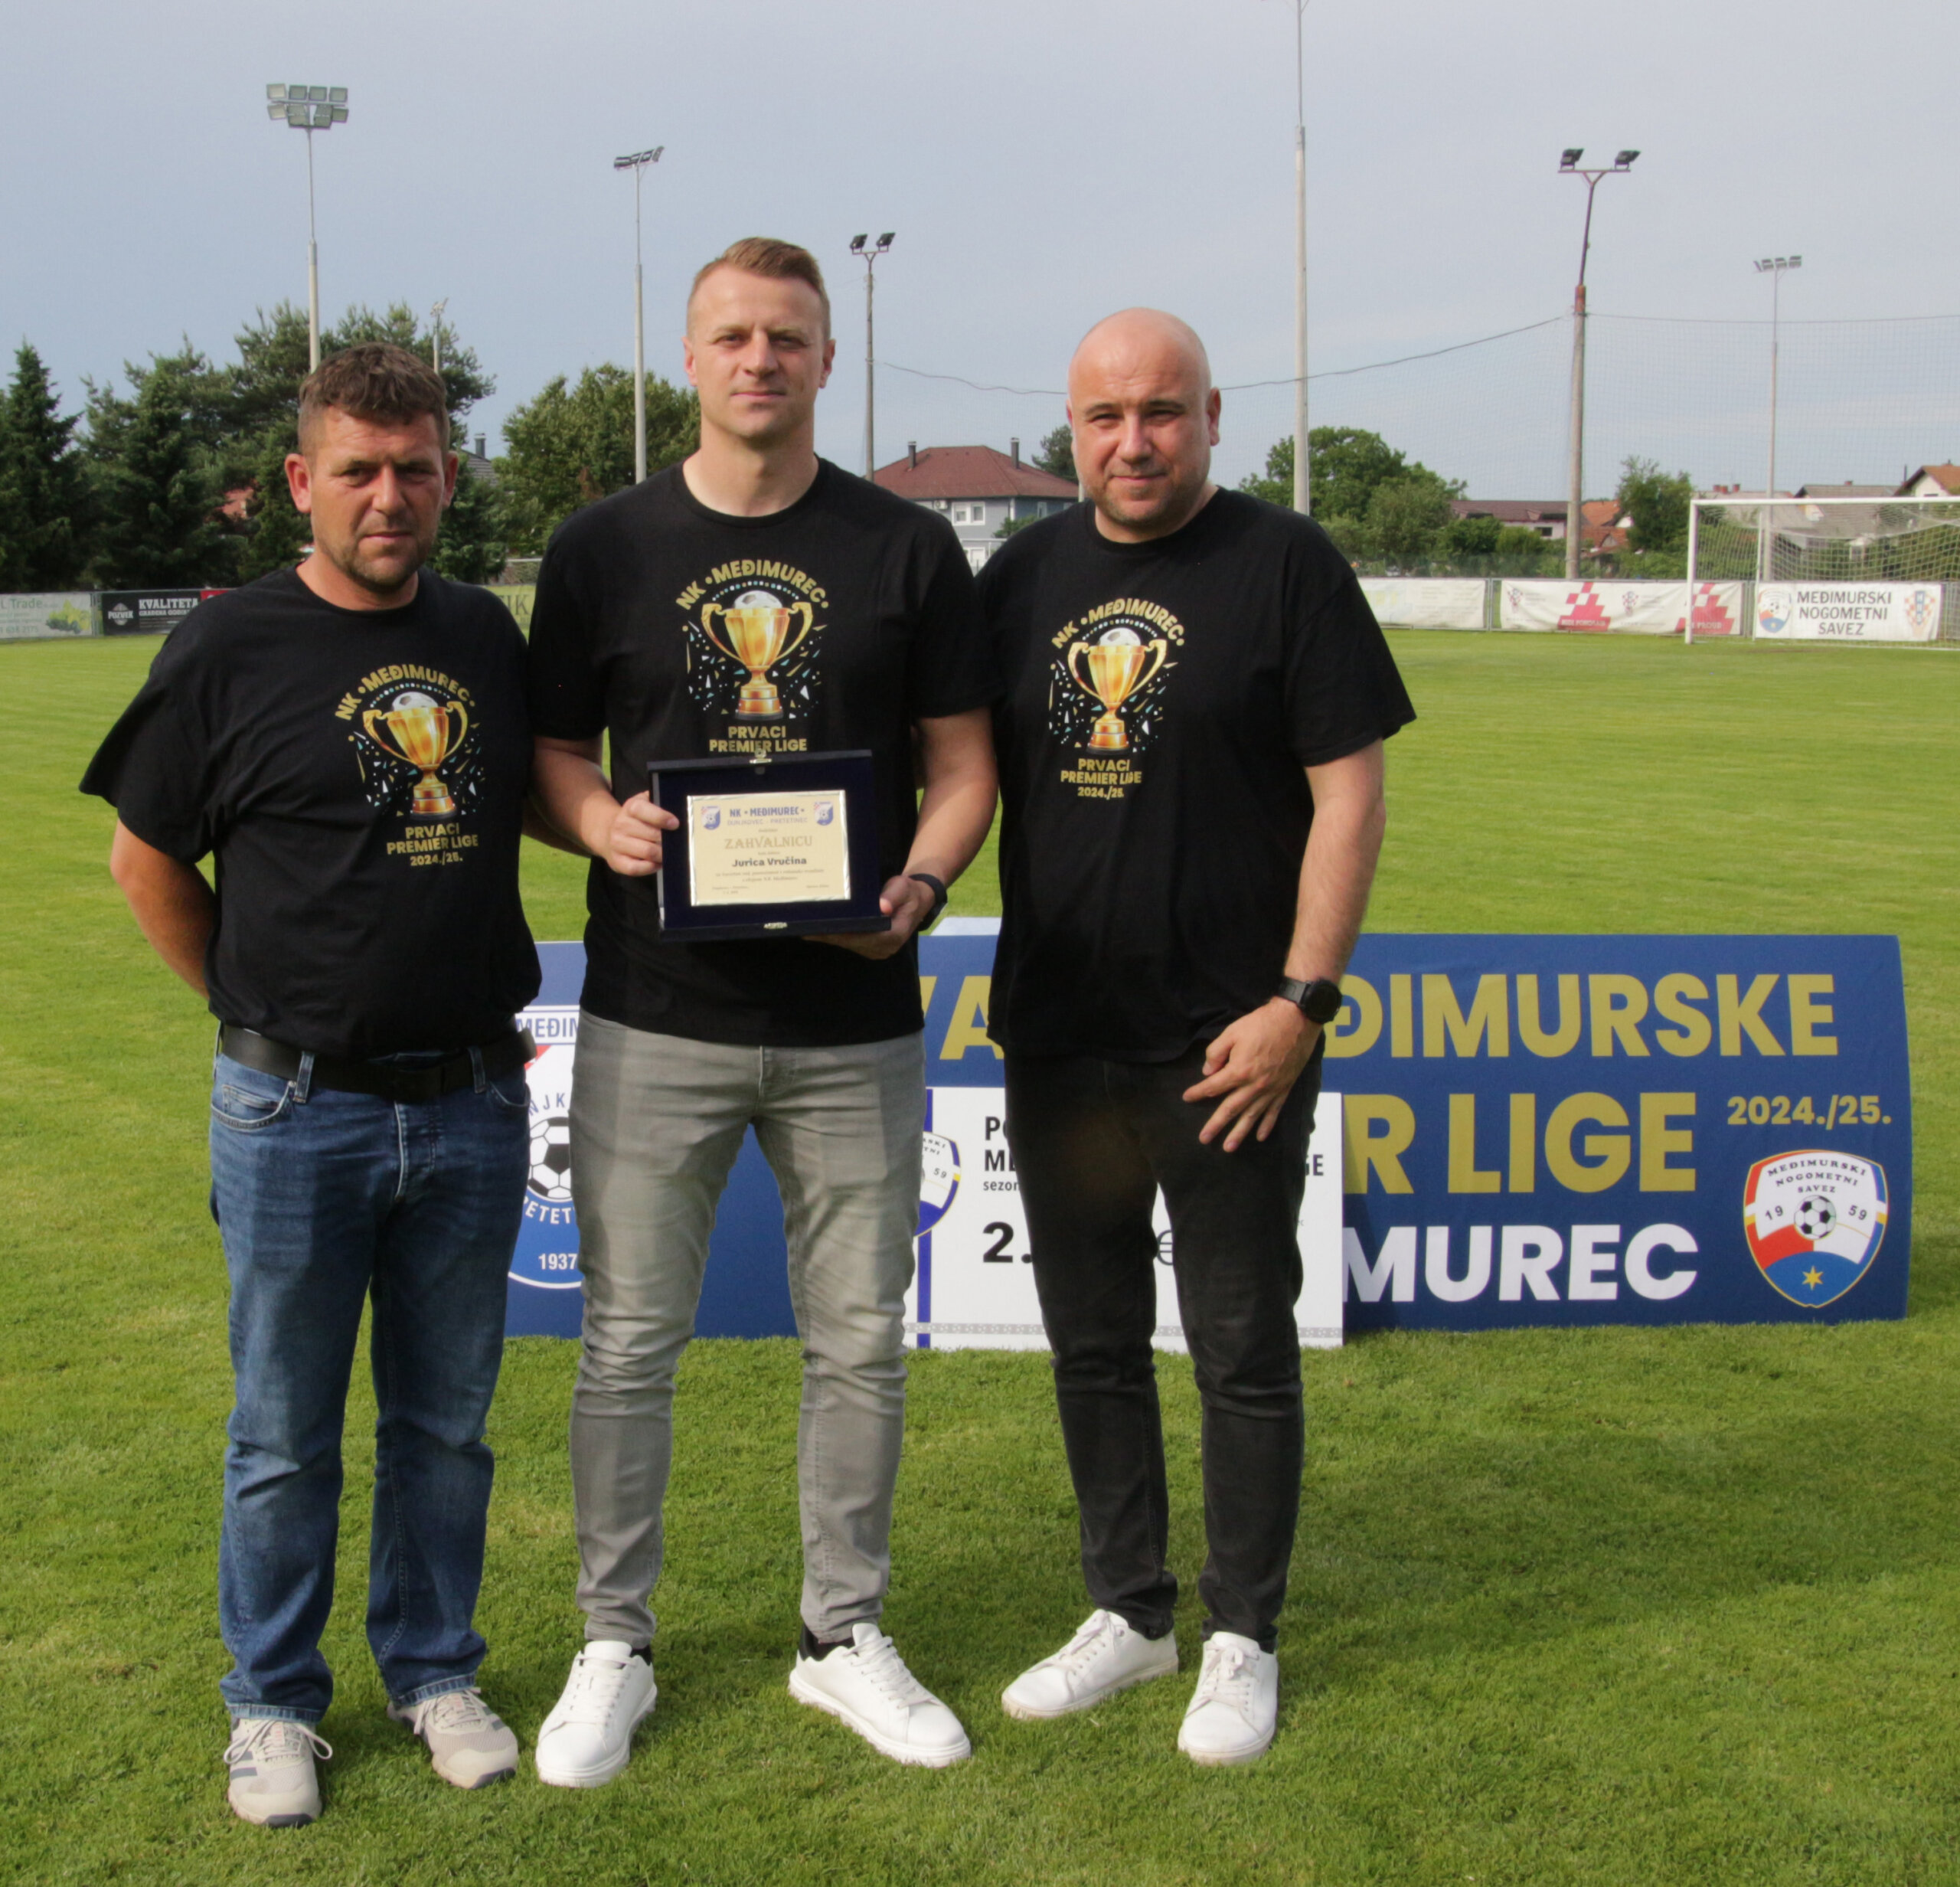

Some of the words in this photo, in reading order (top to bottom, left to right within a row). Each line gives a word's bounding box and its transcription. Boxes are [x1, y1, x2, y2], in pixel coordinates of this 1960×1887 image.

[676, 580, 706, 610] NK
[1797, 591, 1892, 604] MEĐIMURSKI
[9, 597, 42, 609] Trade
[139, 597, 198, 610] KVALITETA
[1799, 607, 1888, 620] NOGOMETNI
[1051, 621, 1080, 649] NK
[1818, 622, 1865, 636] SAVEZ
[335, 692, 362, 721] NK
[728, 726, 786, 739] PRVACI
[709, 739, 771, 752] PREMIER
[775, 738, 807, 751] LIGE
[1078, 758, 1130, 771] PRVACI
[1060, 770, 1118, 784] PREMIER
[730, 809, 741, 817] NK
[405, 822, 459, 839] PRVACI
[387, 838, 449, 855] PREMIER
[451, 834, 479, 849] LIGE
[724, 836, 812, 849] ZAHVALNICU
[732, 858, 765, 867] Jurica
[767, 856, 807, 865] Vručina
[1448, 1092, 1697, 1193] LIGE
[1727, 1095, 1891, 1130] 2024./25.
[1775, 1172, 1858, 1187] NOGOMETNI
[1798, 1185, 1836, 1193] SAVEZ
[1766, 1205, 1784, 1221] 19
[1849, 1205, 1867, 1221] 59
[538, 1253, 578, 1270] 1937
